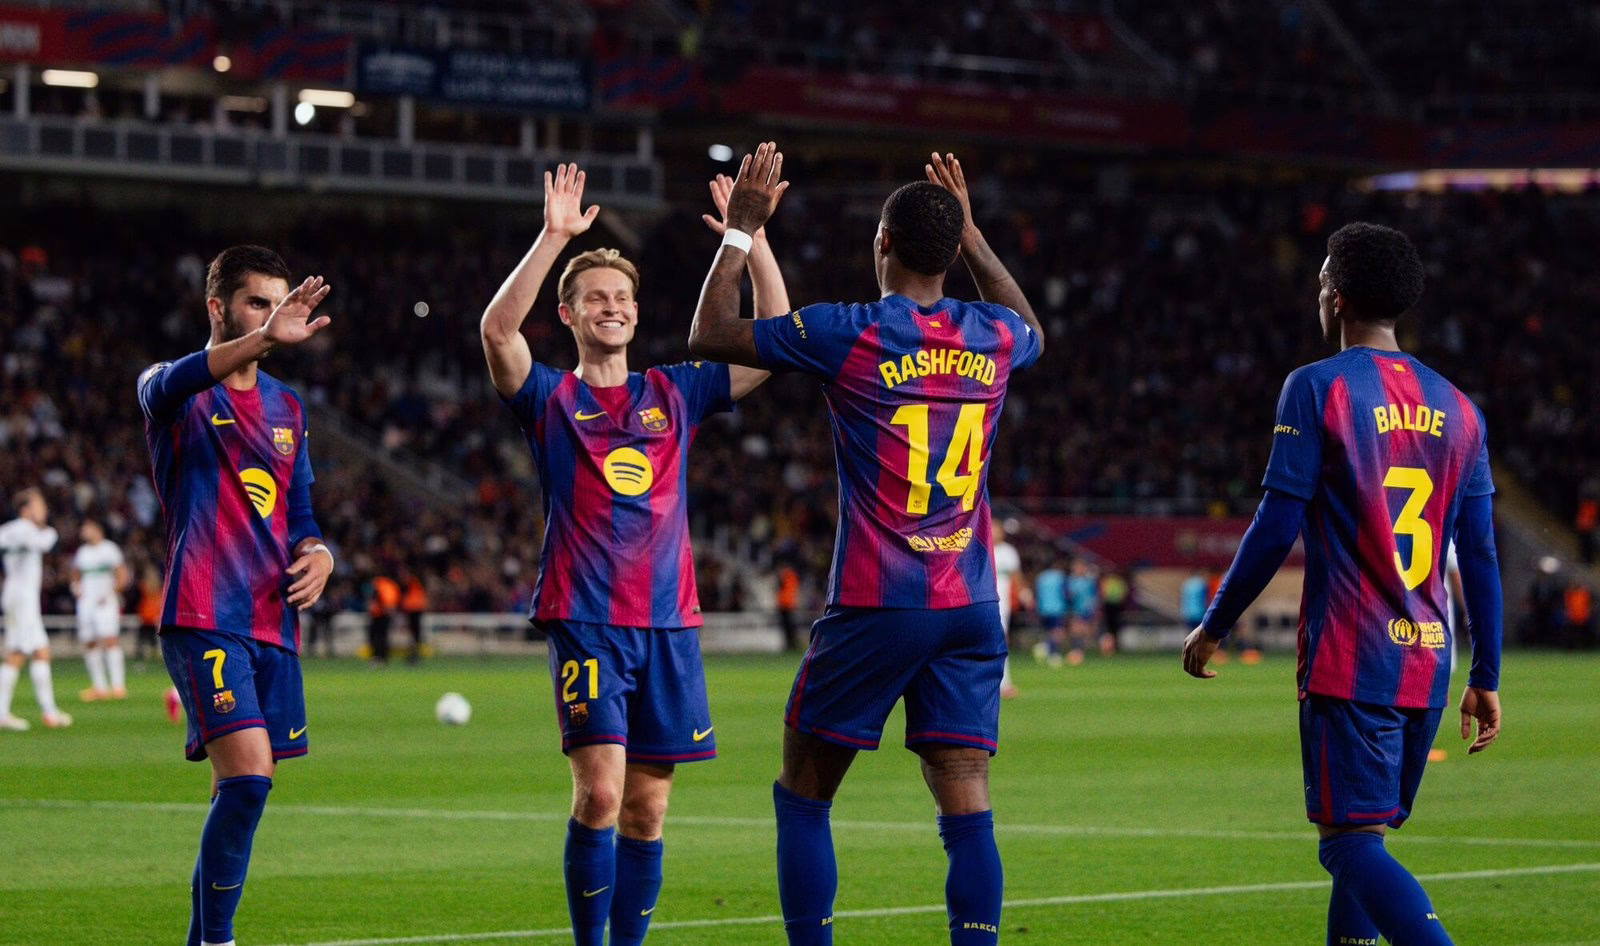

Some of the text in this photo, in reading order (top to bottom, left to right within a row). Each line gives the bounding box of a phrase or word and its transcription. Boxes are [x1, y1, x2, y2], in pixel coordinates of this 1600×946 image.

[879, 349, 996, 389] RASHFORD
[1373, 403, 1446, 438] BALDE
[890, 404, 986, 514] 14
[1382, 466, 1433, 590] 3
[203, 649, 226, 689] 7
[562, 658, 599, 703] 21
